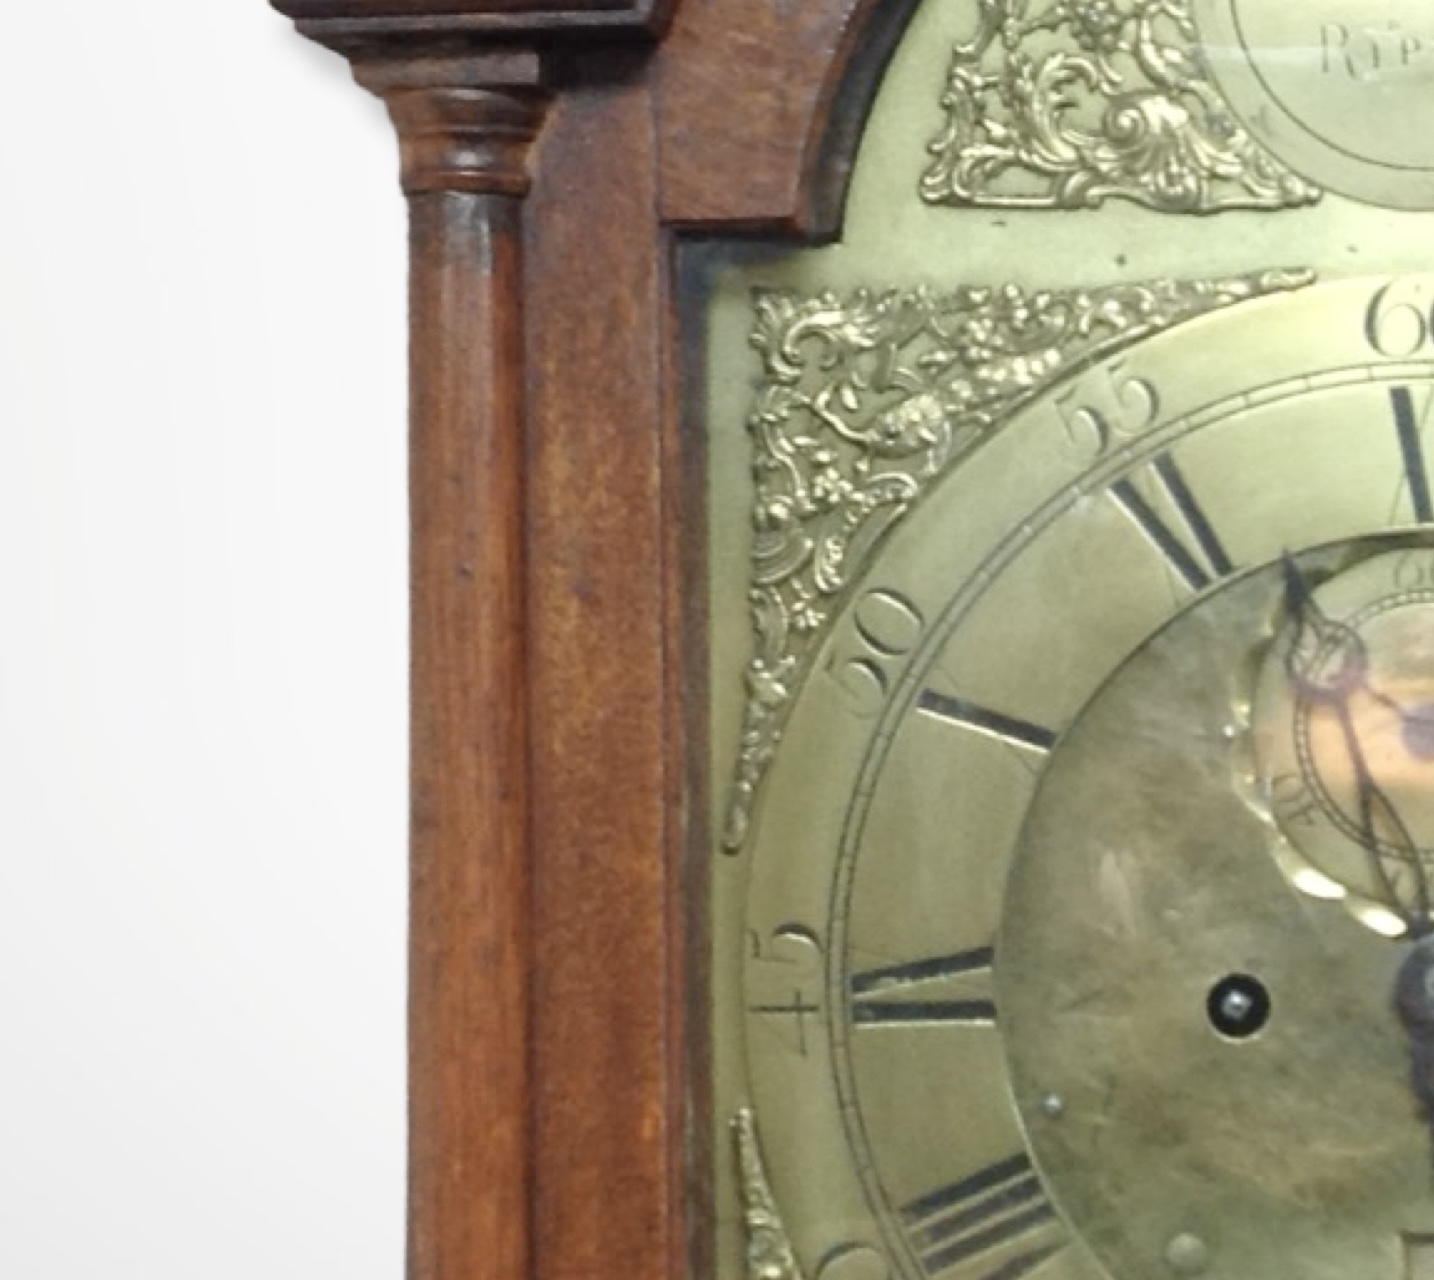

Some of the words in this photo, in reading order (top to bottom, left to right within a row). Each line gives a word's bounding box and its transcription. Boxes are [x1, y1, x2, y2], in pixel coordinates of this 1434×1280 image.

[1054, 360, 1160, 450] 55
[822, 588, 924, 717] 50
[747, 922, 823, 1057] 45
